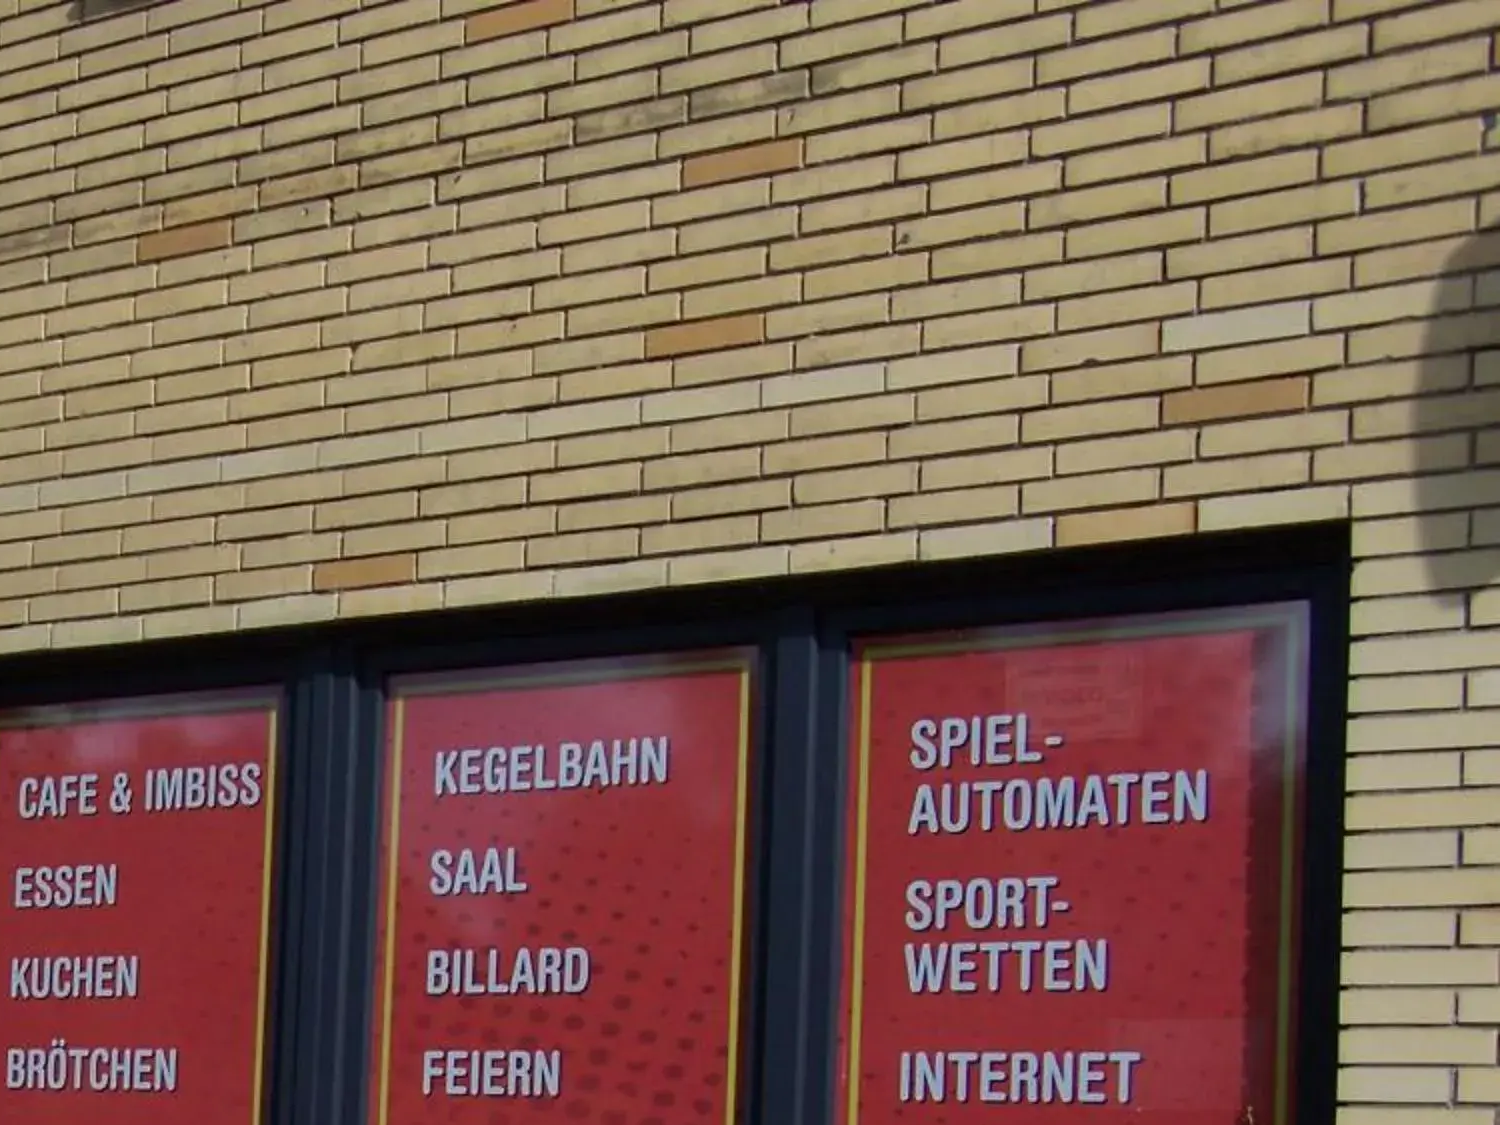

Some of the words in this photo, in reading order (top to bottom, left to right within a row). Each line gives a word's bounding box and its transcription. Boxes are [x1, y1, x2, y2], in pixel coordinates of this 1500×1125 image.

[434, 735, 669, 796] KEGELBAHN
[910, 713, 1063, 770] SPIEL-
[18, 773, 99, 818] CAFE
[108, 771, 133, 813] &
[144, 762, 262, 812] IMBISS
[907, 769, 1208, 836] AUTOMATEN
[14, 863, 119, 909] ESSEN
[429, 847, 528, 896] SAAL
[904, 875, 1070, 931] SPORT-
[10, 955, 139, 999] KUCHEN
[426, 946, 591, 996] BILLARD
[904, 939, 1109, 994] WETTEN
[5, 1039, 178, 1091] BRÖTCHEN
[421, 1050, 562, 1097] FEIERN
[900, 1051, 1143, 1105] INTERNET
